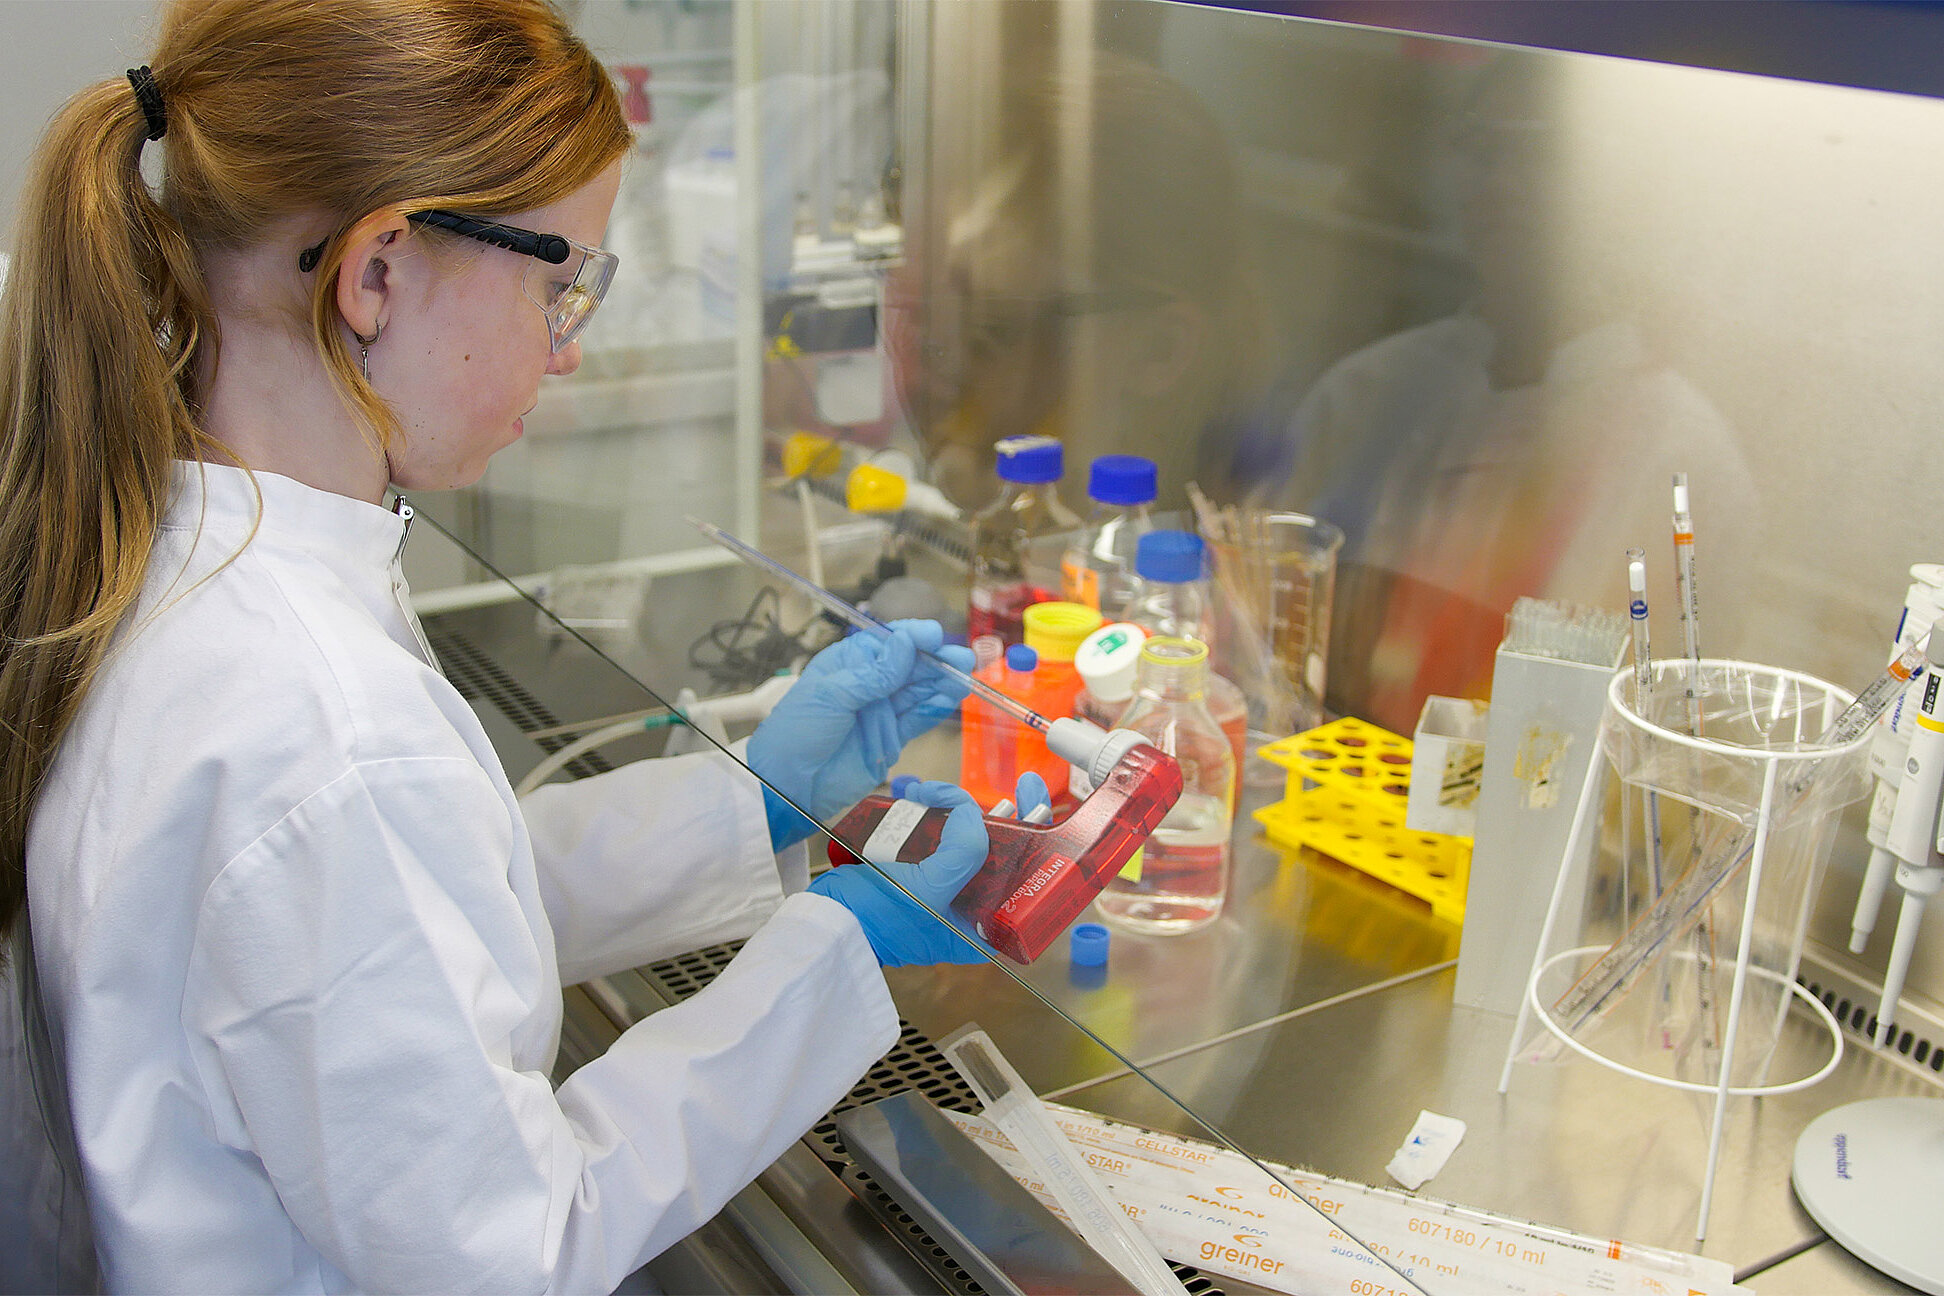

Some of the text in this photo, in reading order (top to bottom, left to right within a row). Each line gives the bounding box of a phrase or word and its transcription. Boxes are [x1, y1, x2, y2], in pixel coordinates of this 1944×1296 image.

[1024, 859, 1065, 896] INTEGRA
[1199, 1240, 1285, 1275] greiner
[1408, 1217, 1476, 1247] 607180
[1480, 1237, 1491, 1250] /
[1495, 1240, 1517, 1257] 10
[1521, 1249, 1546, 1266] ml
